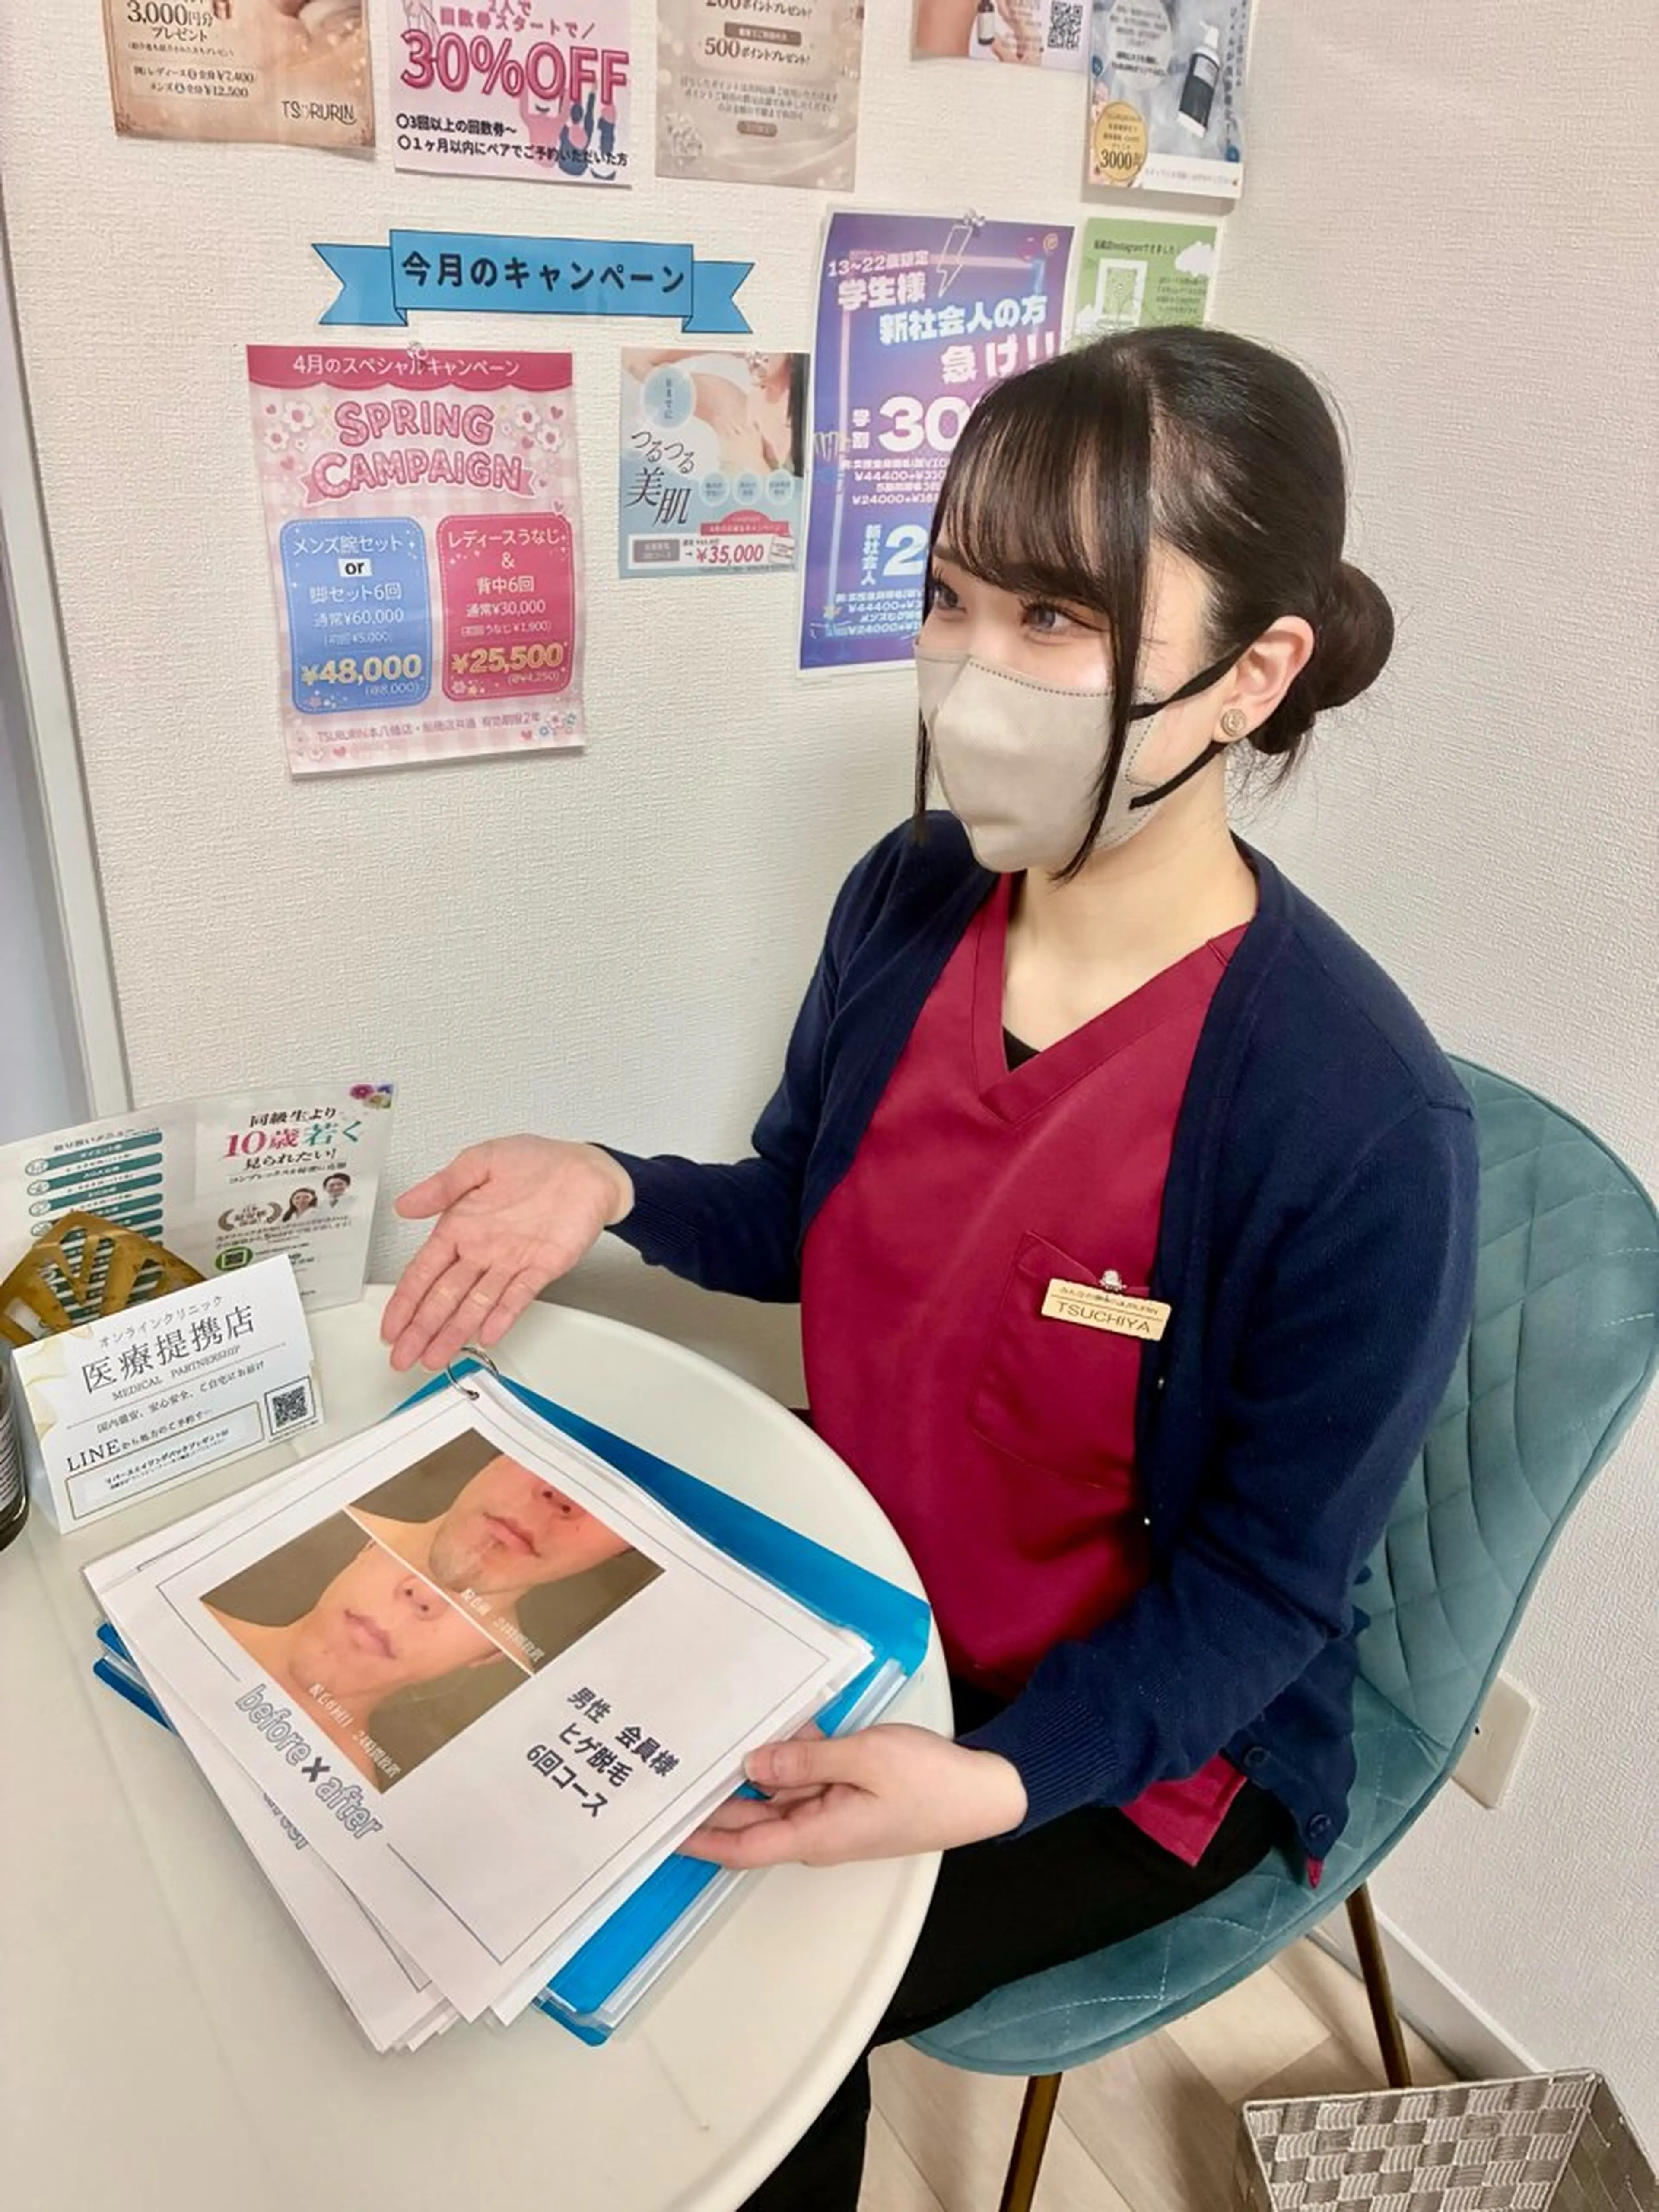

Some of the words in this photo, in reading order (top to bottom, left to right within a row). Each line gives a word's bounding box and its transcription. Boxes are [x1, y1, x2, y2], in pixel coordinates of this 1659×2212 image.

[152, 26, 208, 41] プレゼント
[400, 28, 630, 105] 30%OFF
[401, 250, 685, 294] 今月のキャンペーン
[838, 271, 926, 311] 学生様
[879, 295, 1048, 345] 新社会人の方
[334, 399, 495, 448] SPRING
[878, 396, 980, 453] 30
[311, 447, 522, 499] CAMPAIGN
[631, 431, 696, 474] つるつる
[624, 466, 692, 528] 美肌
[448, 528, 560, 549] レディースうなじ
[502, 551, 515, 569] &
[696, 543, 764, 566] ¥35,000
[345, 561, 365, 575] or
[477, 575, 534, 596] 背中6回
[300, 653, 422, 686] ¥48,000
[451, 642, 564, 674] ¥25,500
[1057, 1301, 1152, 1334] TSUCHIYA
[82, 1304, 255, 1394] 医療提携店
[112, 1376, 164, 1402] MEDICAL
[170, 1344, 242, 1379] PARTNERSHIP
[567, 1686, 612, 1724] 男性
[614, 1725, 680, 1777] 会員様
[235, 1683, 312, 1767] before
[315, 1776, 384, 1840] after
[559, 1722, 634, 1788] ヒゲ脱毛
[526, 1744, 609, 1818] 6回コース
